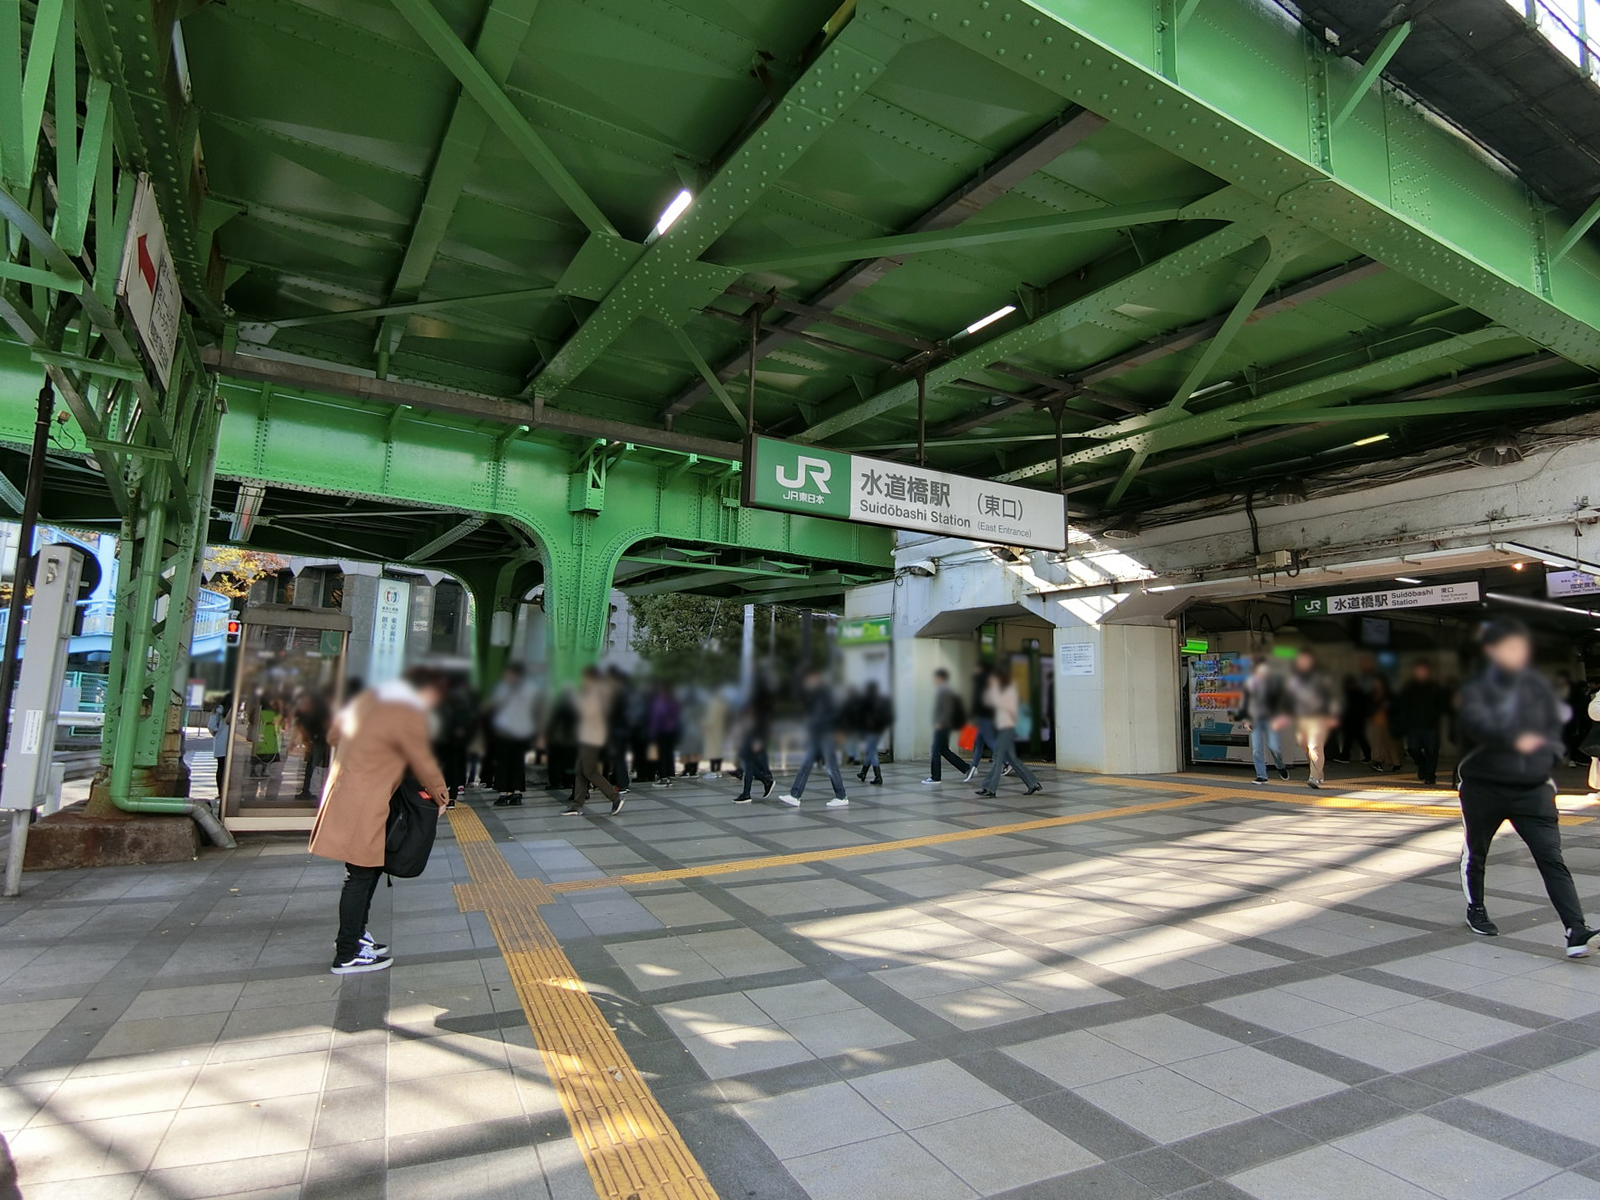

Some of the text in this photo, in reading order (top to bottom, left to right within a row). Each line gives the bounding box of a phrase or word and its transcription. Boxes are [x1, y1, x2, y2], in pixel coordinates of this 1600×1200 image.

[775, 455, 832, 494] JR
[782, 490, 825, 505] JR東日本
[860, 469, 1024, 521] 水道橋駅 （東口）
[859, 499, 1032, 539] Suidōbashi Station (East Entrance)
[1304, 600, 1321, 610] JR
[1334, 593, 1388, 611] 水道橋駅
[1391, 598, 1419, 606] Station
